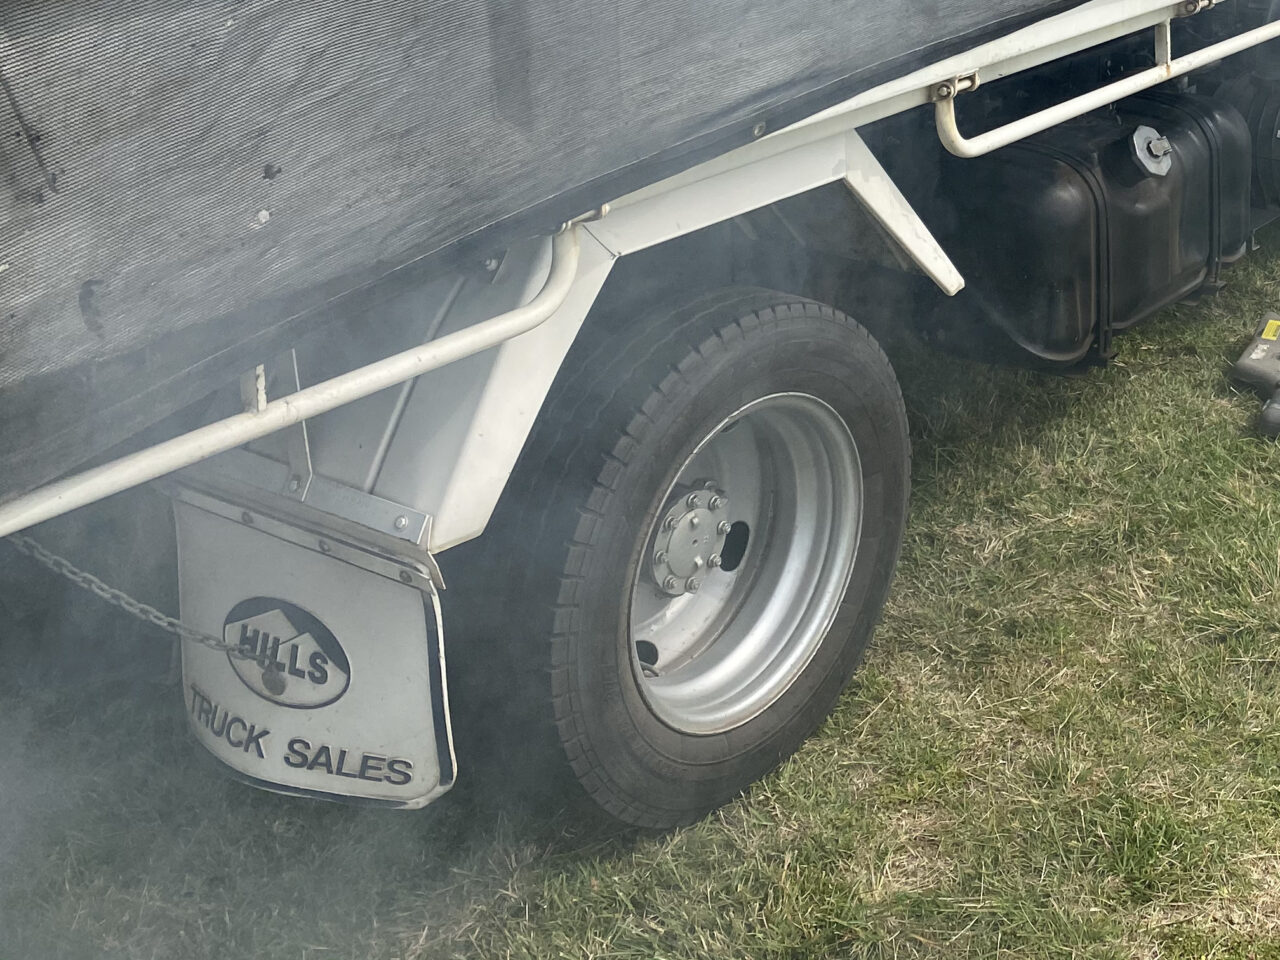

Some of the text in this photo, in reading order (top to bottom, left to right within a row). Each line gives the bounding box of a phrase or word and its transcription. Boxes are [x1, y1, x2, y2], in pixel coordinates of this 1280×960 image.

[239, 623, 329, 685] HILLS
[190, 683, 414, 786] TRUCK SALES
